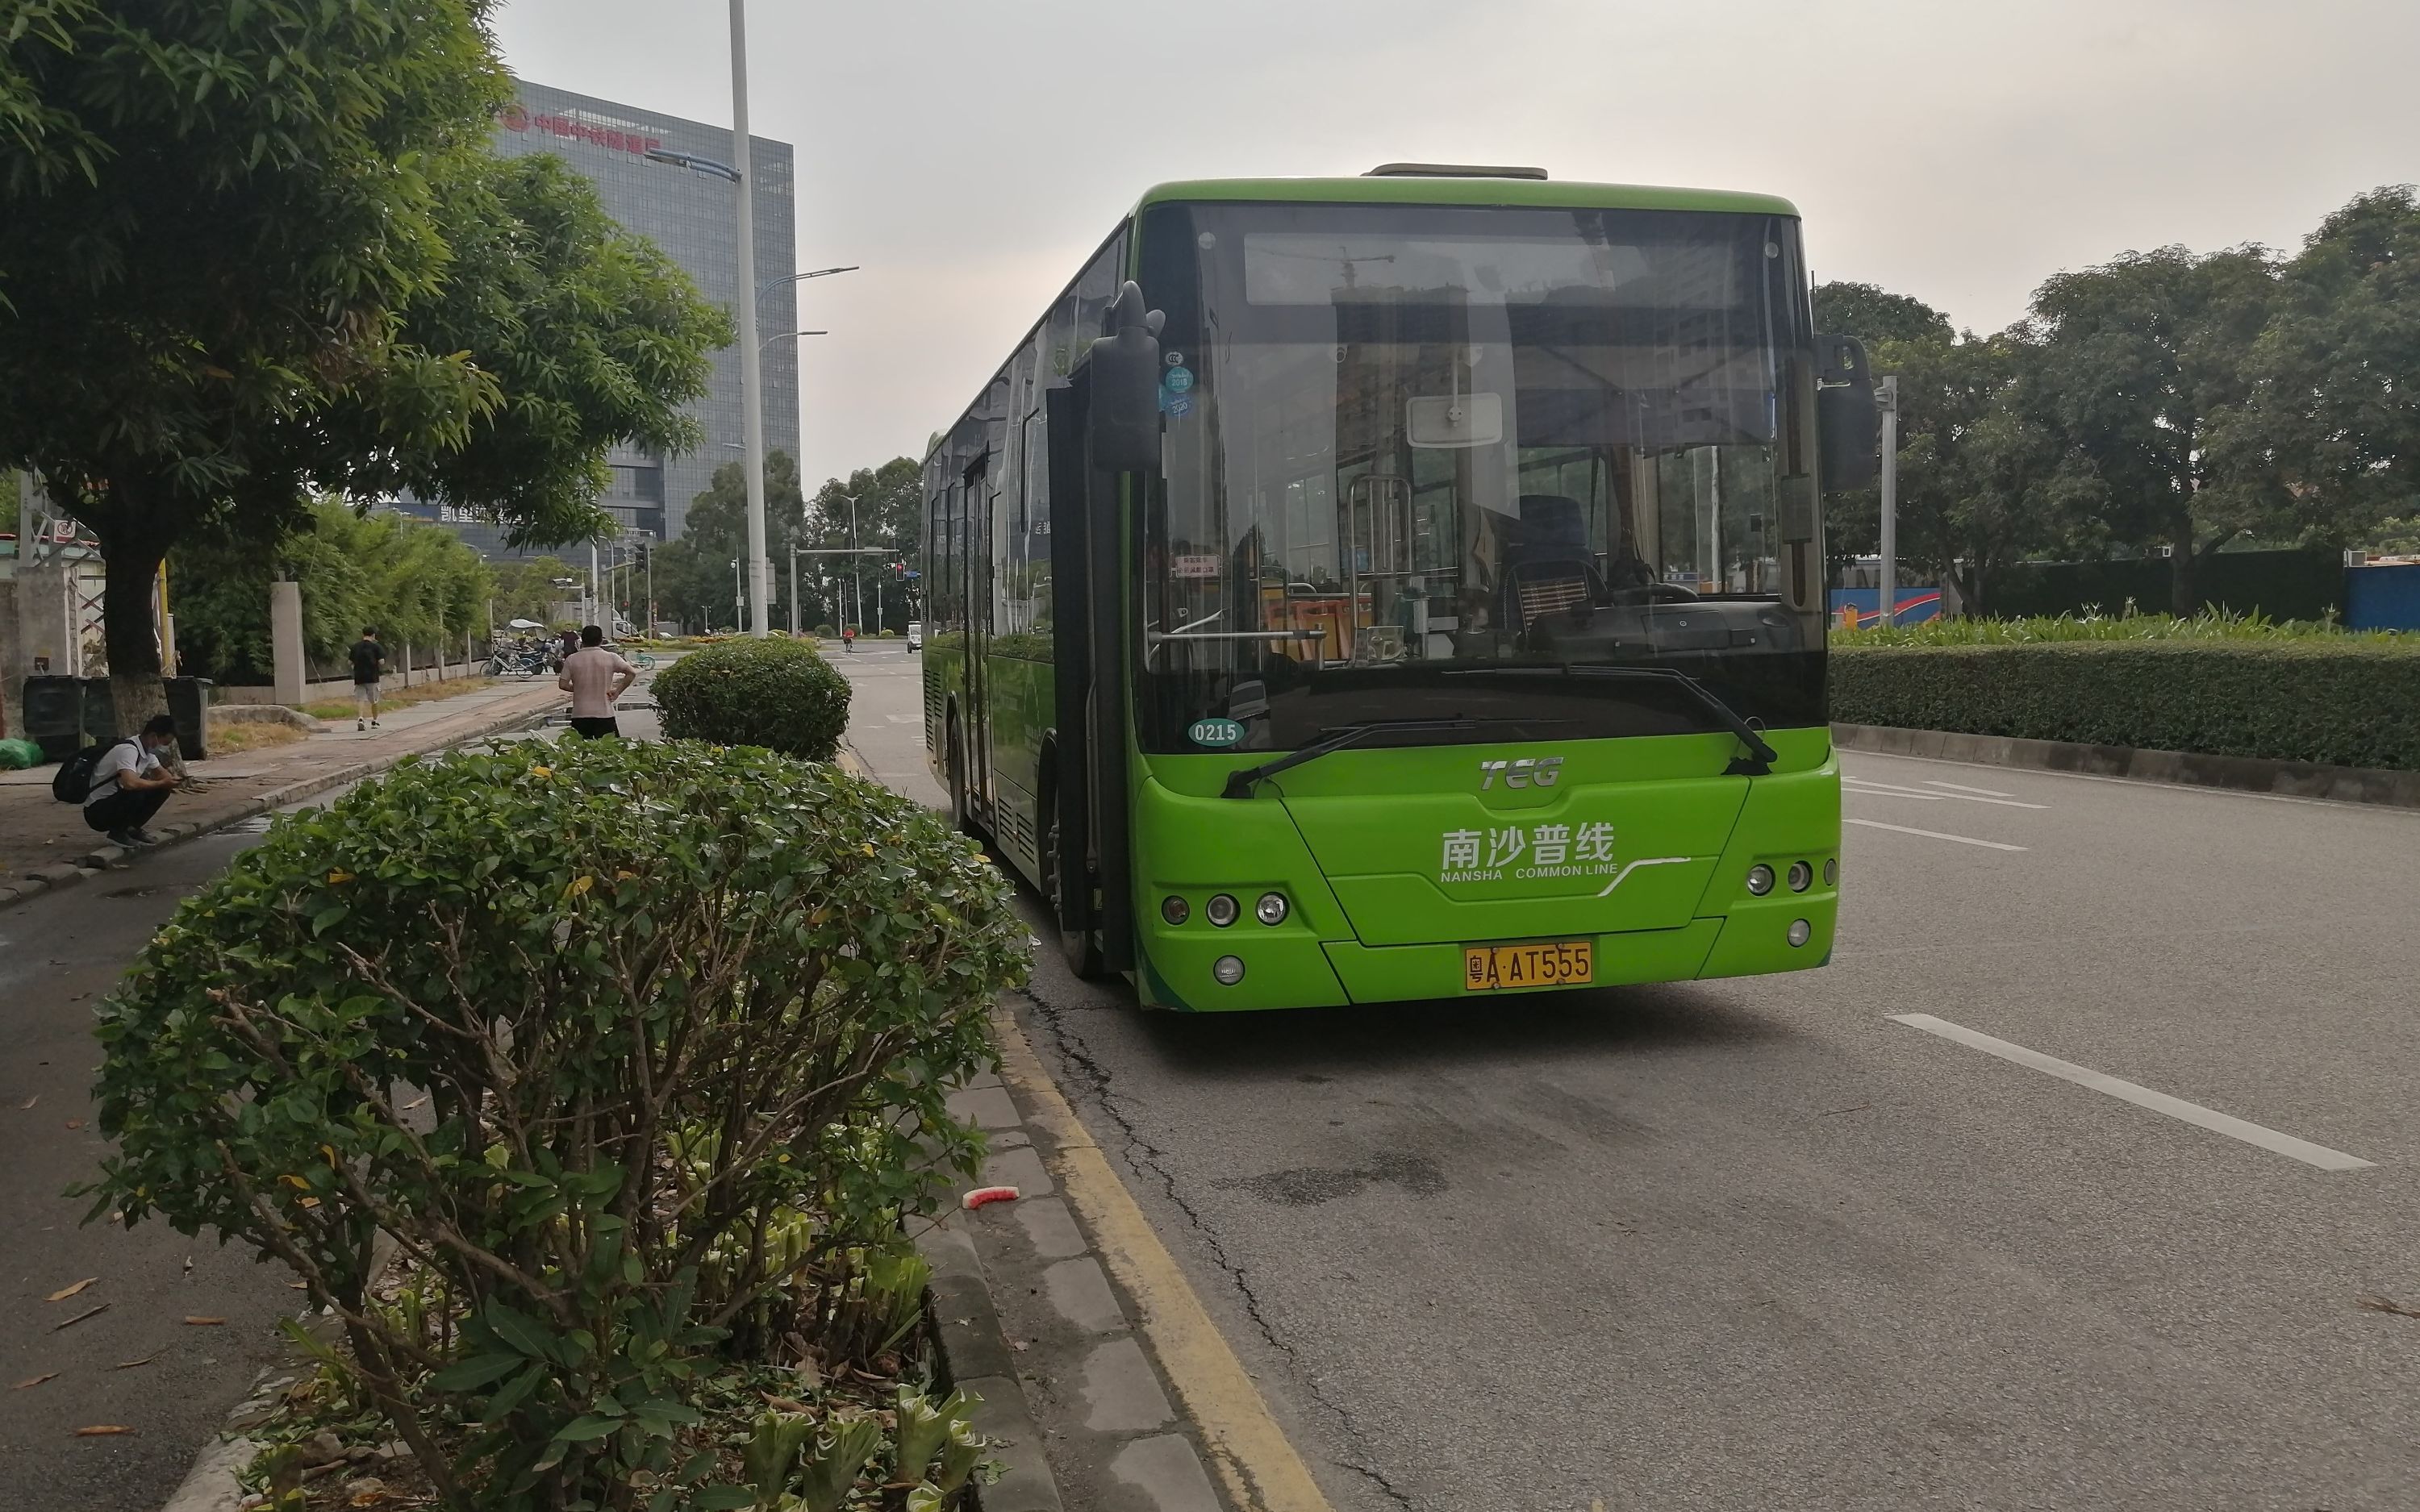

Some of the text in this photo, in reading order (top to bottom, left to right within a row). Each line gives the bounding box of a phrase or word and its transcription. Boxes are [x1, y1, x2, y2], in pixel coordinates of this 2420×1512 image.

[1195, 724, 1237, 740] 0215
[1480, 757, 1563, 790] TEG
[1442, 822, 1614, 870] 南沙普线
[1441, 863, 1618, 882] NANSHA COMMON LINE
